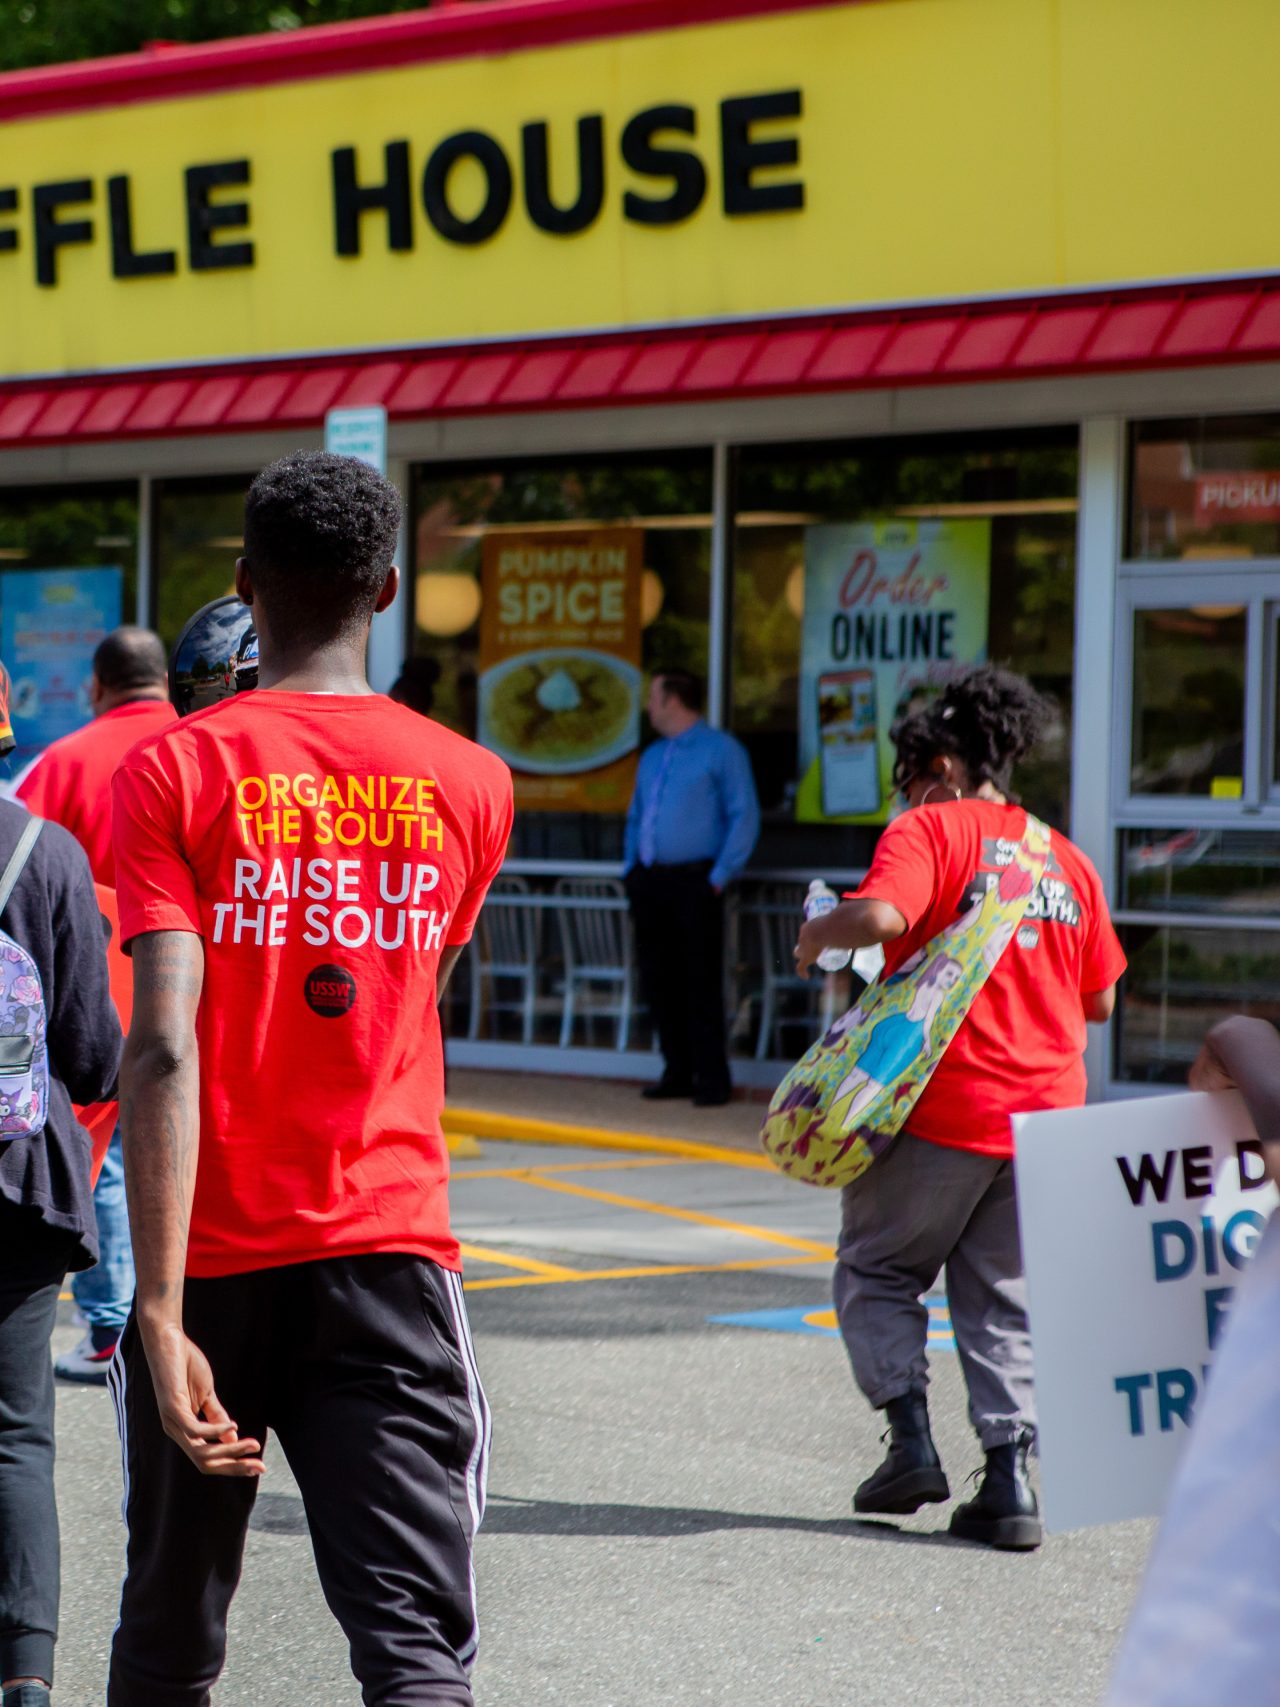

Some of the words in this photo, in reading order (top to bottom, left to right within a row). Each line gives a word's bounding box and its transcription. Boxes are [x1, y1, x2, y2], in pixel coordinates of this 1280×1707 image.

[331, 88, 806, 259] HOUSE
[1201, 479, 1280, 509] PICKU
[498, 549, 627, 578] PUMPKIN
[838, 548, 950, 609] Order
[498, 580, 626, 624] SPICE
[831, 612, 956, 662] ONLINE
[236, 773, 436, 813] ORGANIZE
[236, 809, 301, 846] THE
[314, 811, 443, 852] SOUTH
[234, 857, 361, 902] RAISE
[379, 860, 440, 905] UP
[212, 902, 288, 946] THE
[302, 904, 449, 951] SOUTH
[311, 981, 350, 997] USSW
[1115, 1145, 1214, 1207] WE
[1150, 1210, 1268, 1284] DIG
